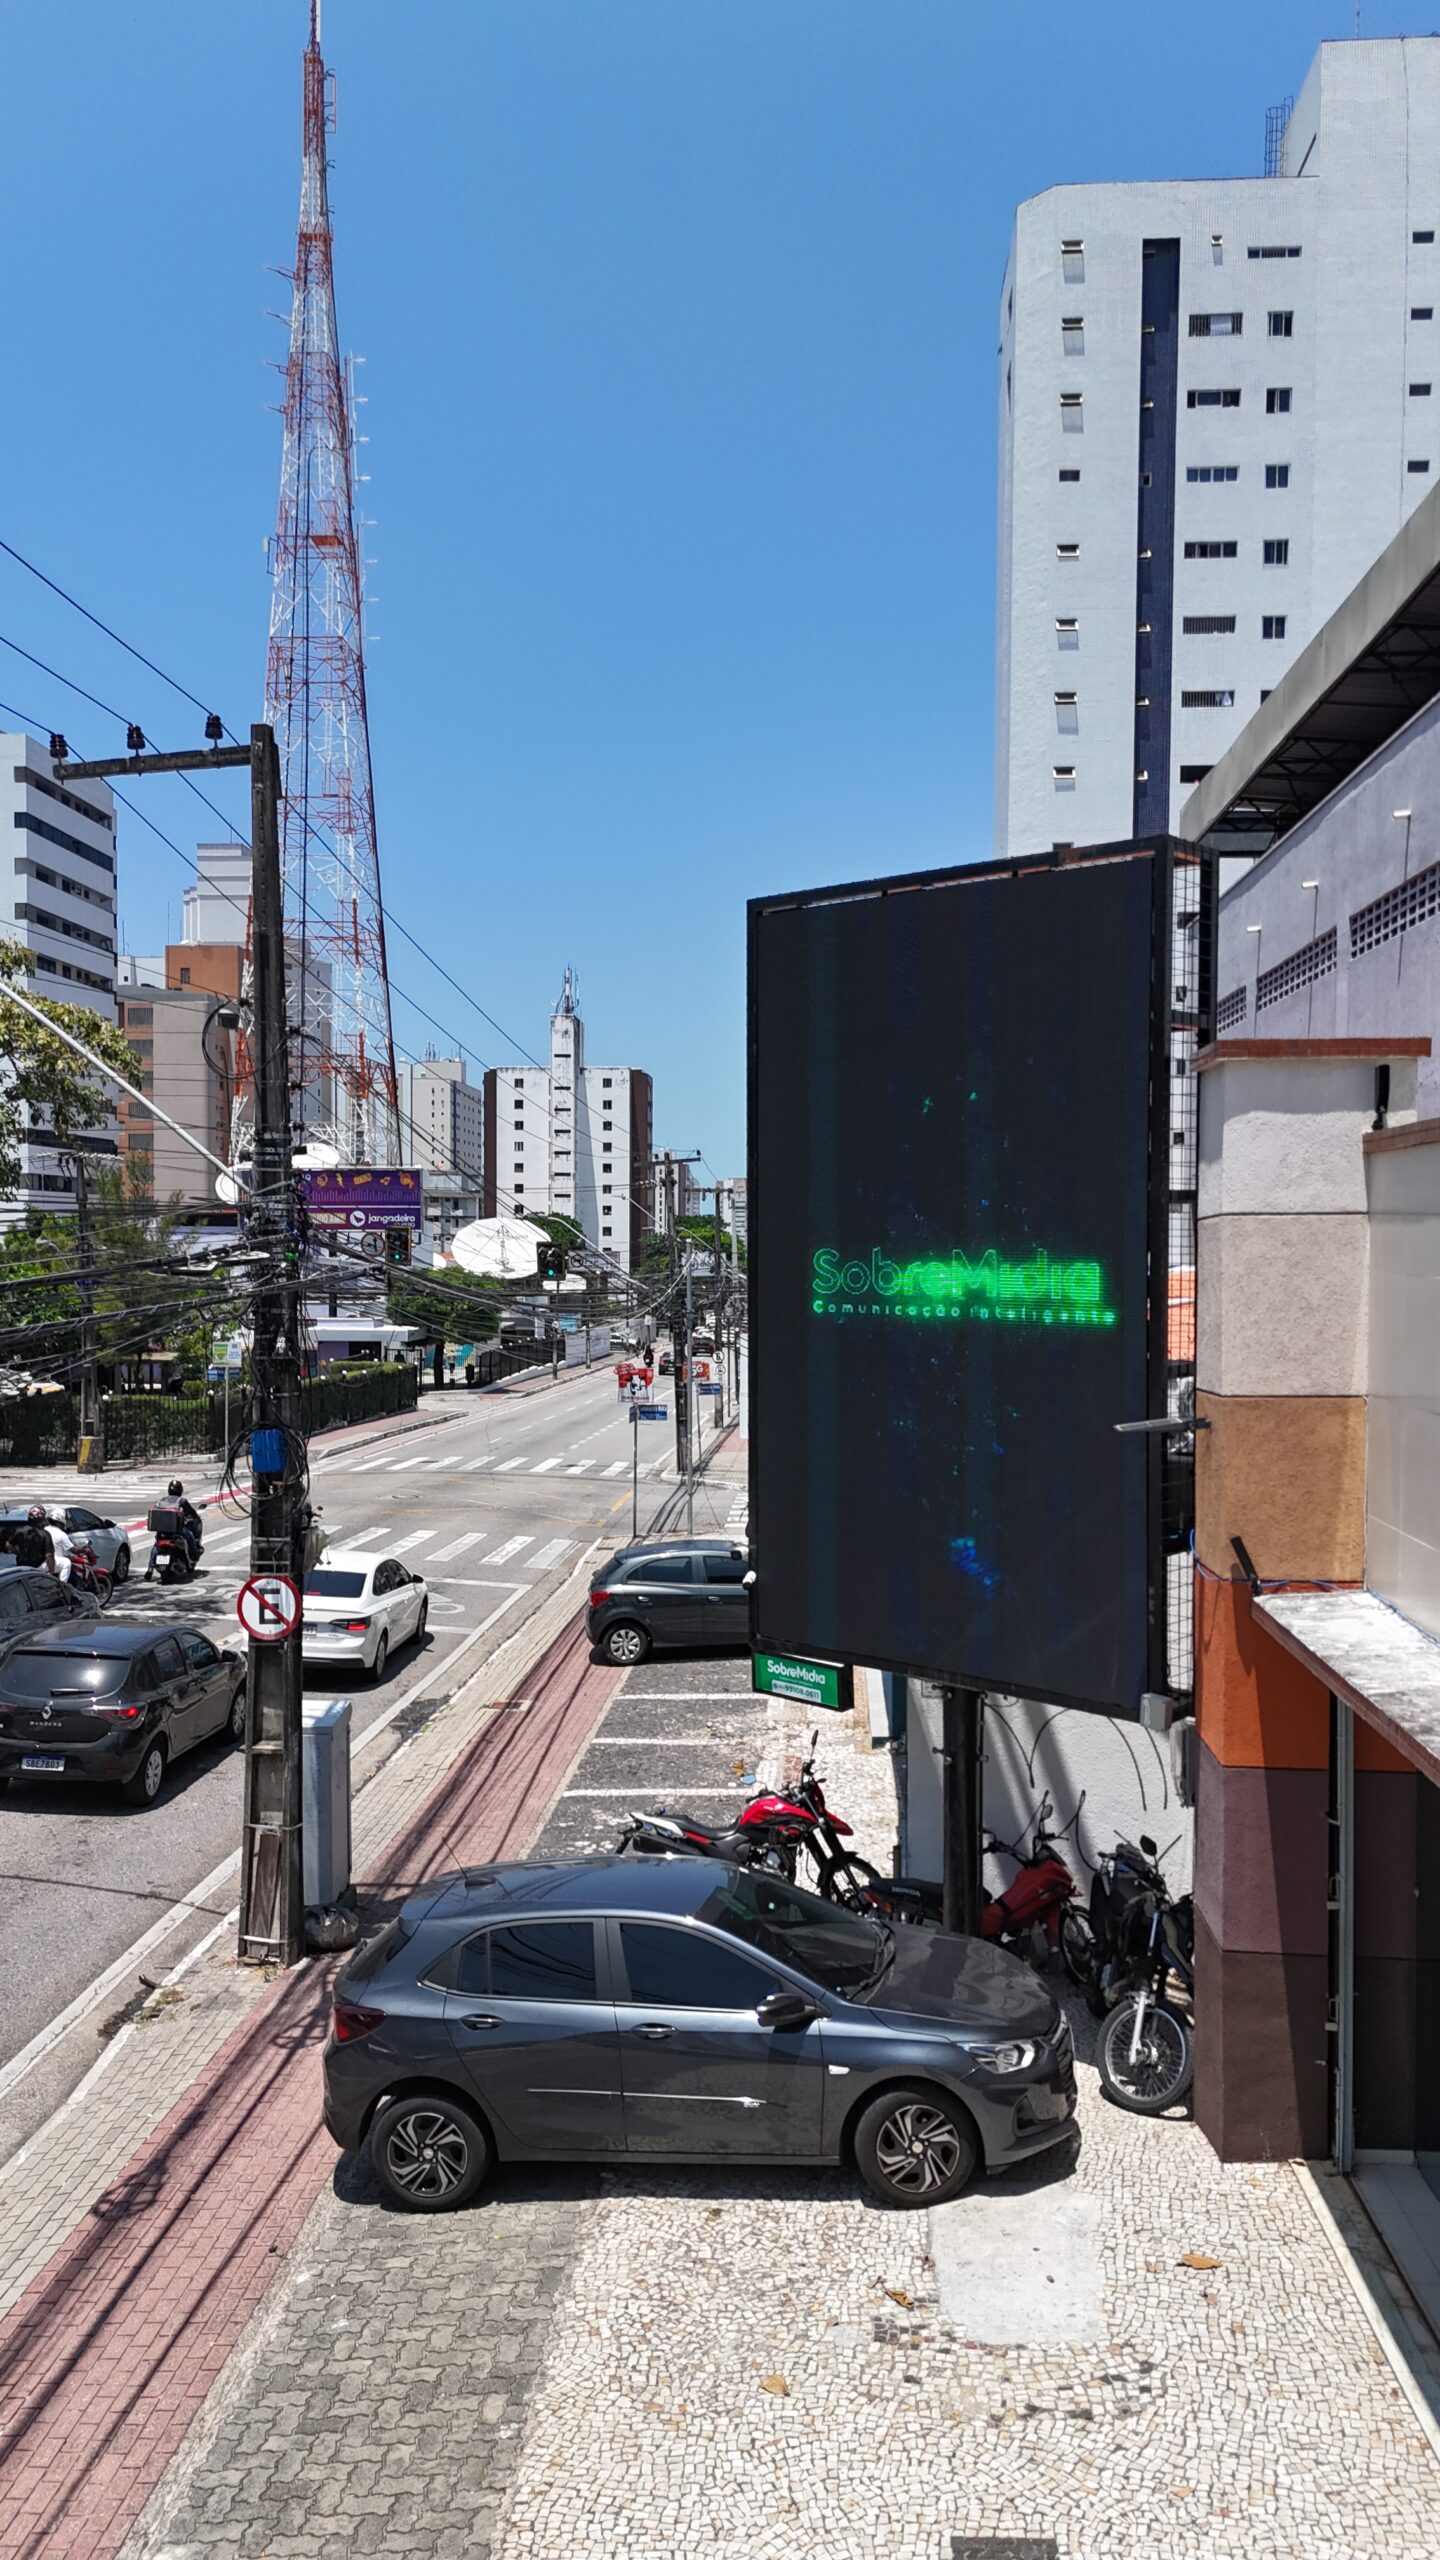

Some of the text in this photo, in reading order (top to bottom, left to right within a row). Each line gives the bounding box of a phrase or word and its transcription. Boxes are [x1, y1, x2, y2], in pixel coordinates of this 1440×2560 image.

[368, 1213, 416, 1224] jangadeiro
[812, 1247, 1100, 1301] SobreMidia
[812, 1299, 962, 1319] Comunicação
[259, 1588, 281, 1625] E
[767, 1660, 826, 1685] SobreMidia
[892, 1886, 921, 1897] HONDA
